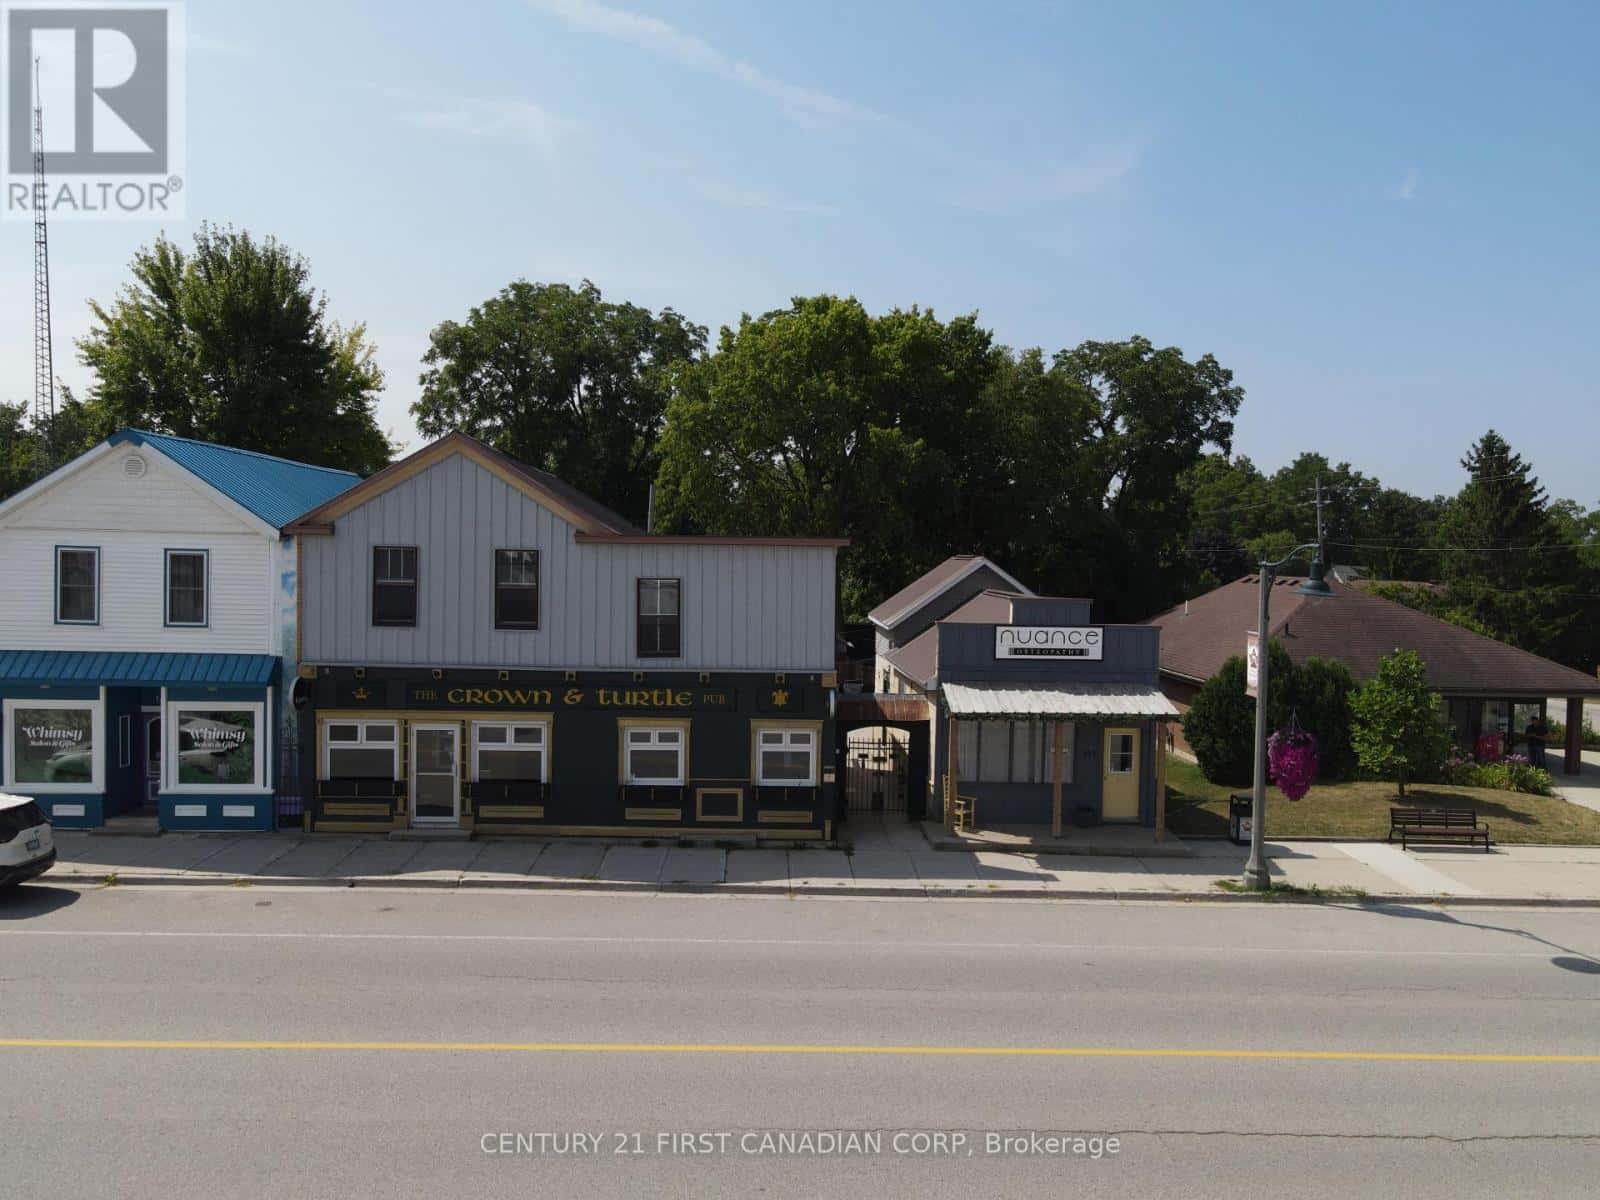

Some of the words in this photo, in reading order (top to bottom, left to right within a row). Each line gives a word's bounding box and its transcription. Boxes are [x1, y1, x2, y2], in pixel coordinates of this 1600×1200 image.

[1000, 629, 1099, 645] nuance
[564, 688, 584, 704] &
[22, 726, 82, 741] Whimsy
[187, 727, 246, 742] Whimsy
